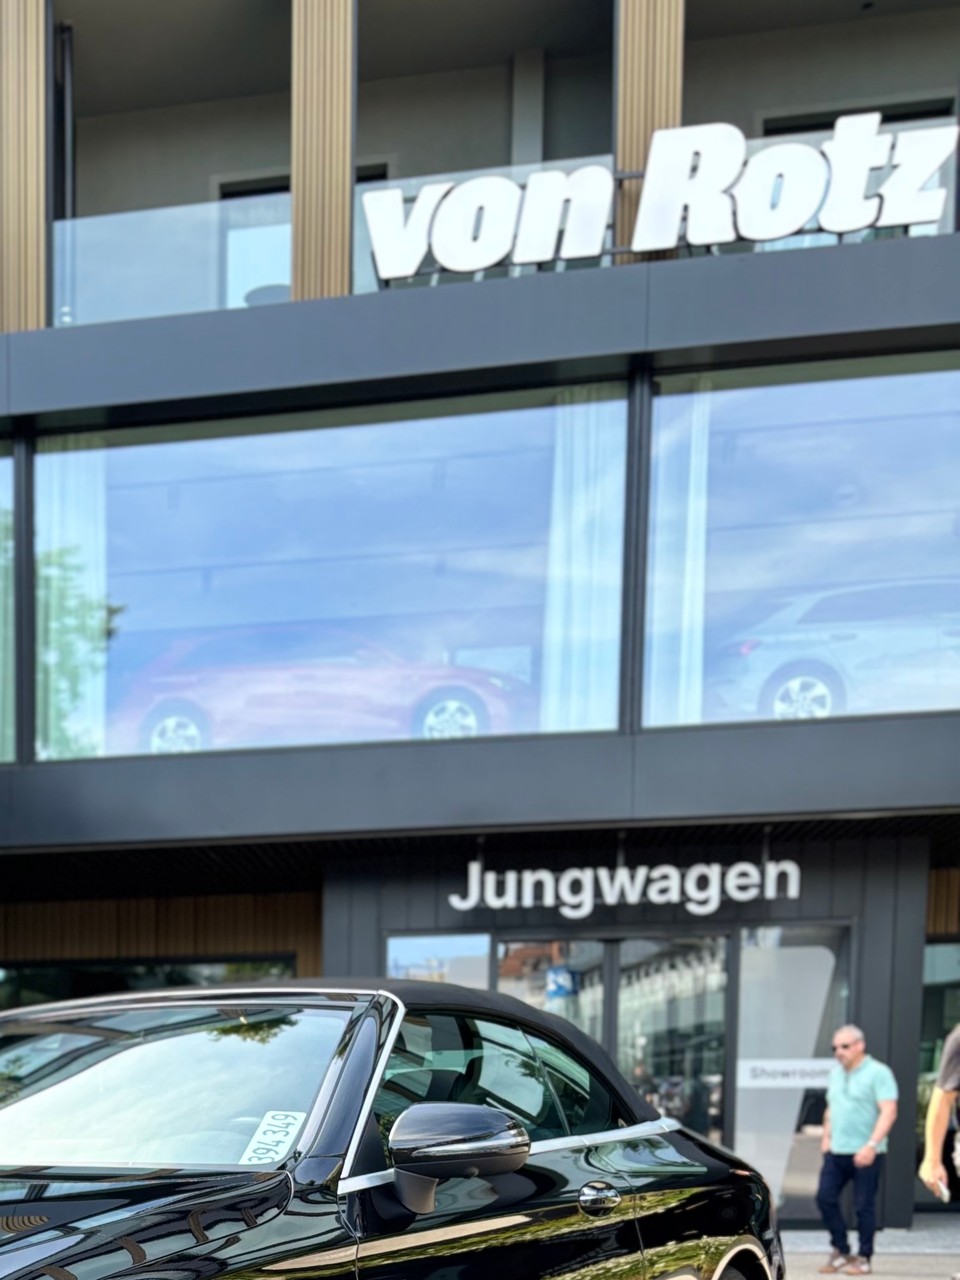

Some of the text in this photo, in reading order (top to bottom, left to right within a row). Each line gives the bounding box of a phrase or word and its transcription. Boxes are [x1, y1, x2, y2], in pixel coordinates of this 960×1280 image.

[362, 112, 960, 280] von Rotz
[448, 859, 801, 920] Jungwagen
